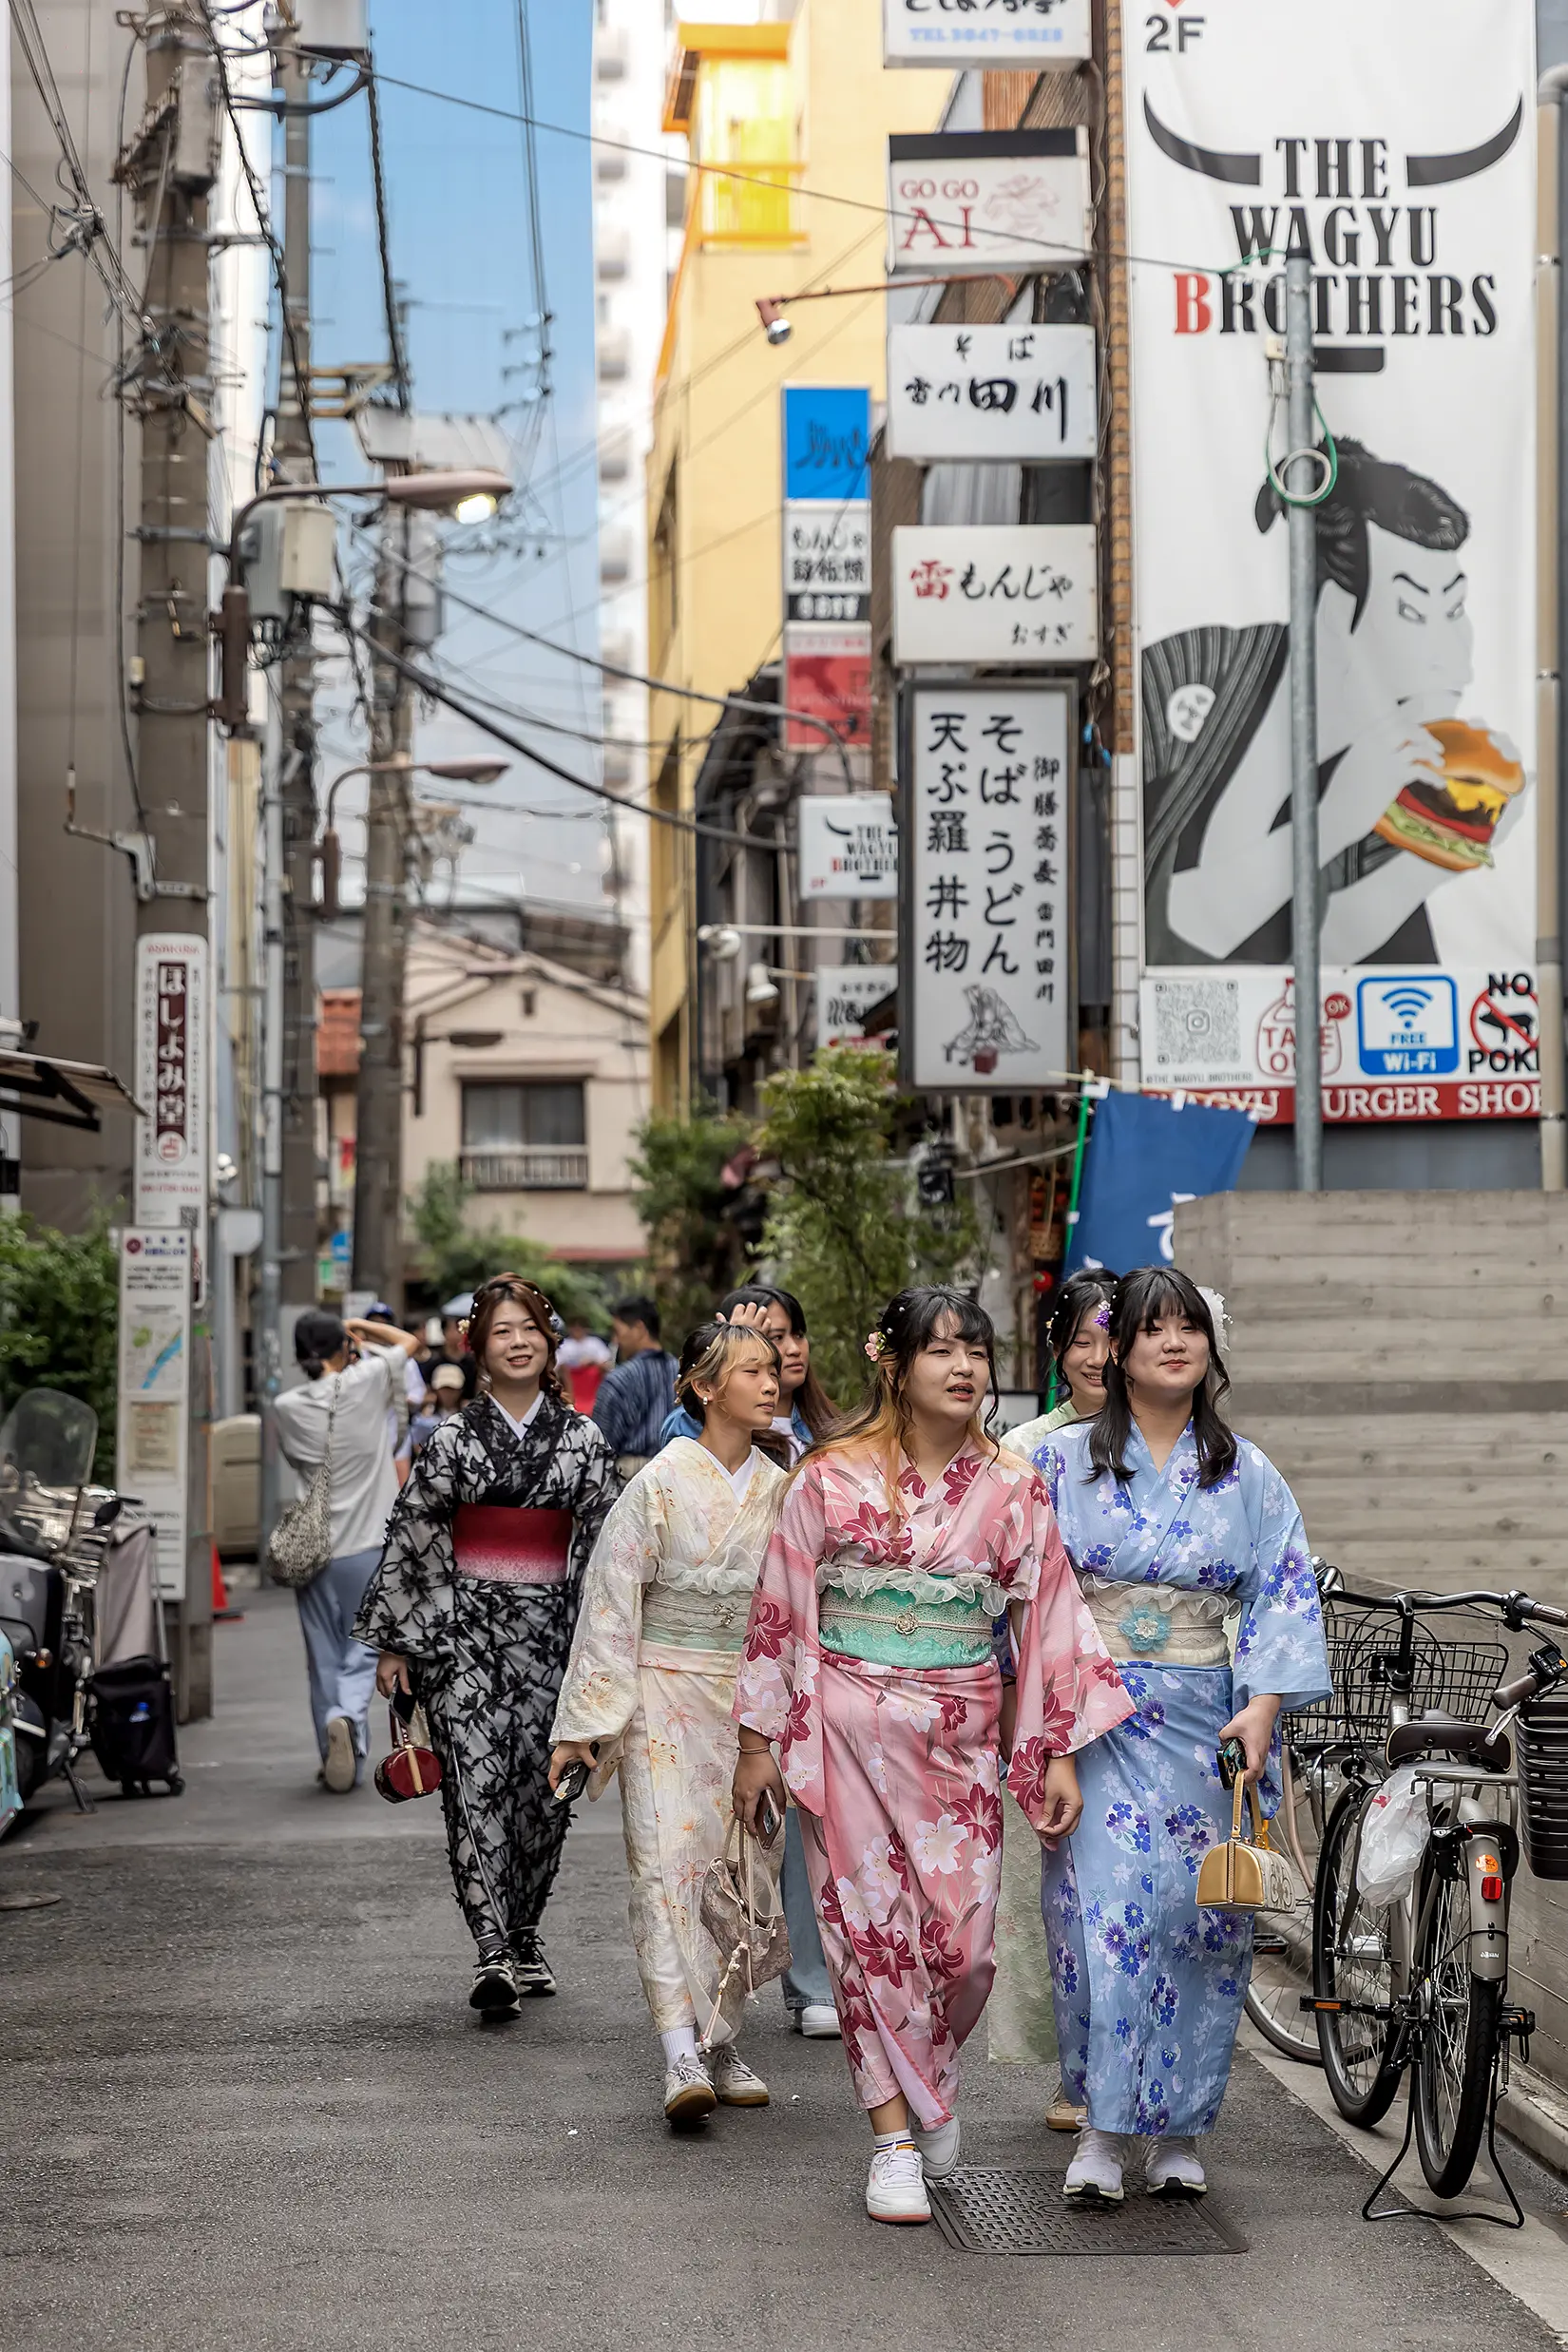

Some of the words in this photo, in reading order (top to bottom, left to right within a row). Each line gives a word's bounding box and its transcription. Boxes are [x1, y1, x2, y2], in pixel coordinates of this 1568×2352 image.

[1145, 16, 1205, 53] 2F
[1275, 138, 1389, 199] THE
[900, 179, 936, 199] GO
[942, 179, 979, 200] GO
[900, 205, 977, 249] AI
[1230, 206, 1438, 267] WAGYU
[1174, 274, 1499, 336] BROTHERS
[955, 334, 1035, 362] そば
[909, 560, 1074, 601] 雷もんじゃ
[981, 715, 1028, 805] そば
[927, 713, 970, 853] 天ぷ羅
[982, 831, 1025, 975] うどん
[926, 874, 970, 974] 丼物
[1487, 973, 1533, 997] NO
[1329, 1000, 1349, 1017] OK
[1263, 1026, 1334, 1048] TAE
[1391, 1032, 1426, 1044] FREE
[1383, 1052, 1437, 1072] Wi-Fi
[1320, 1085, 1443, 1119] URGER
